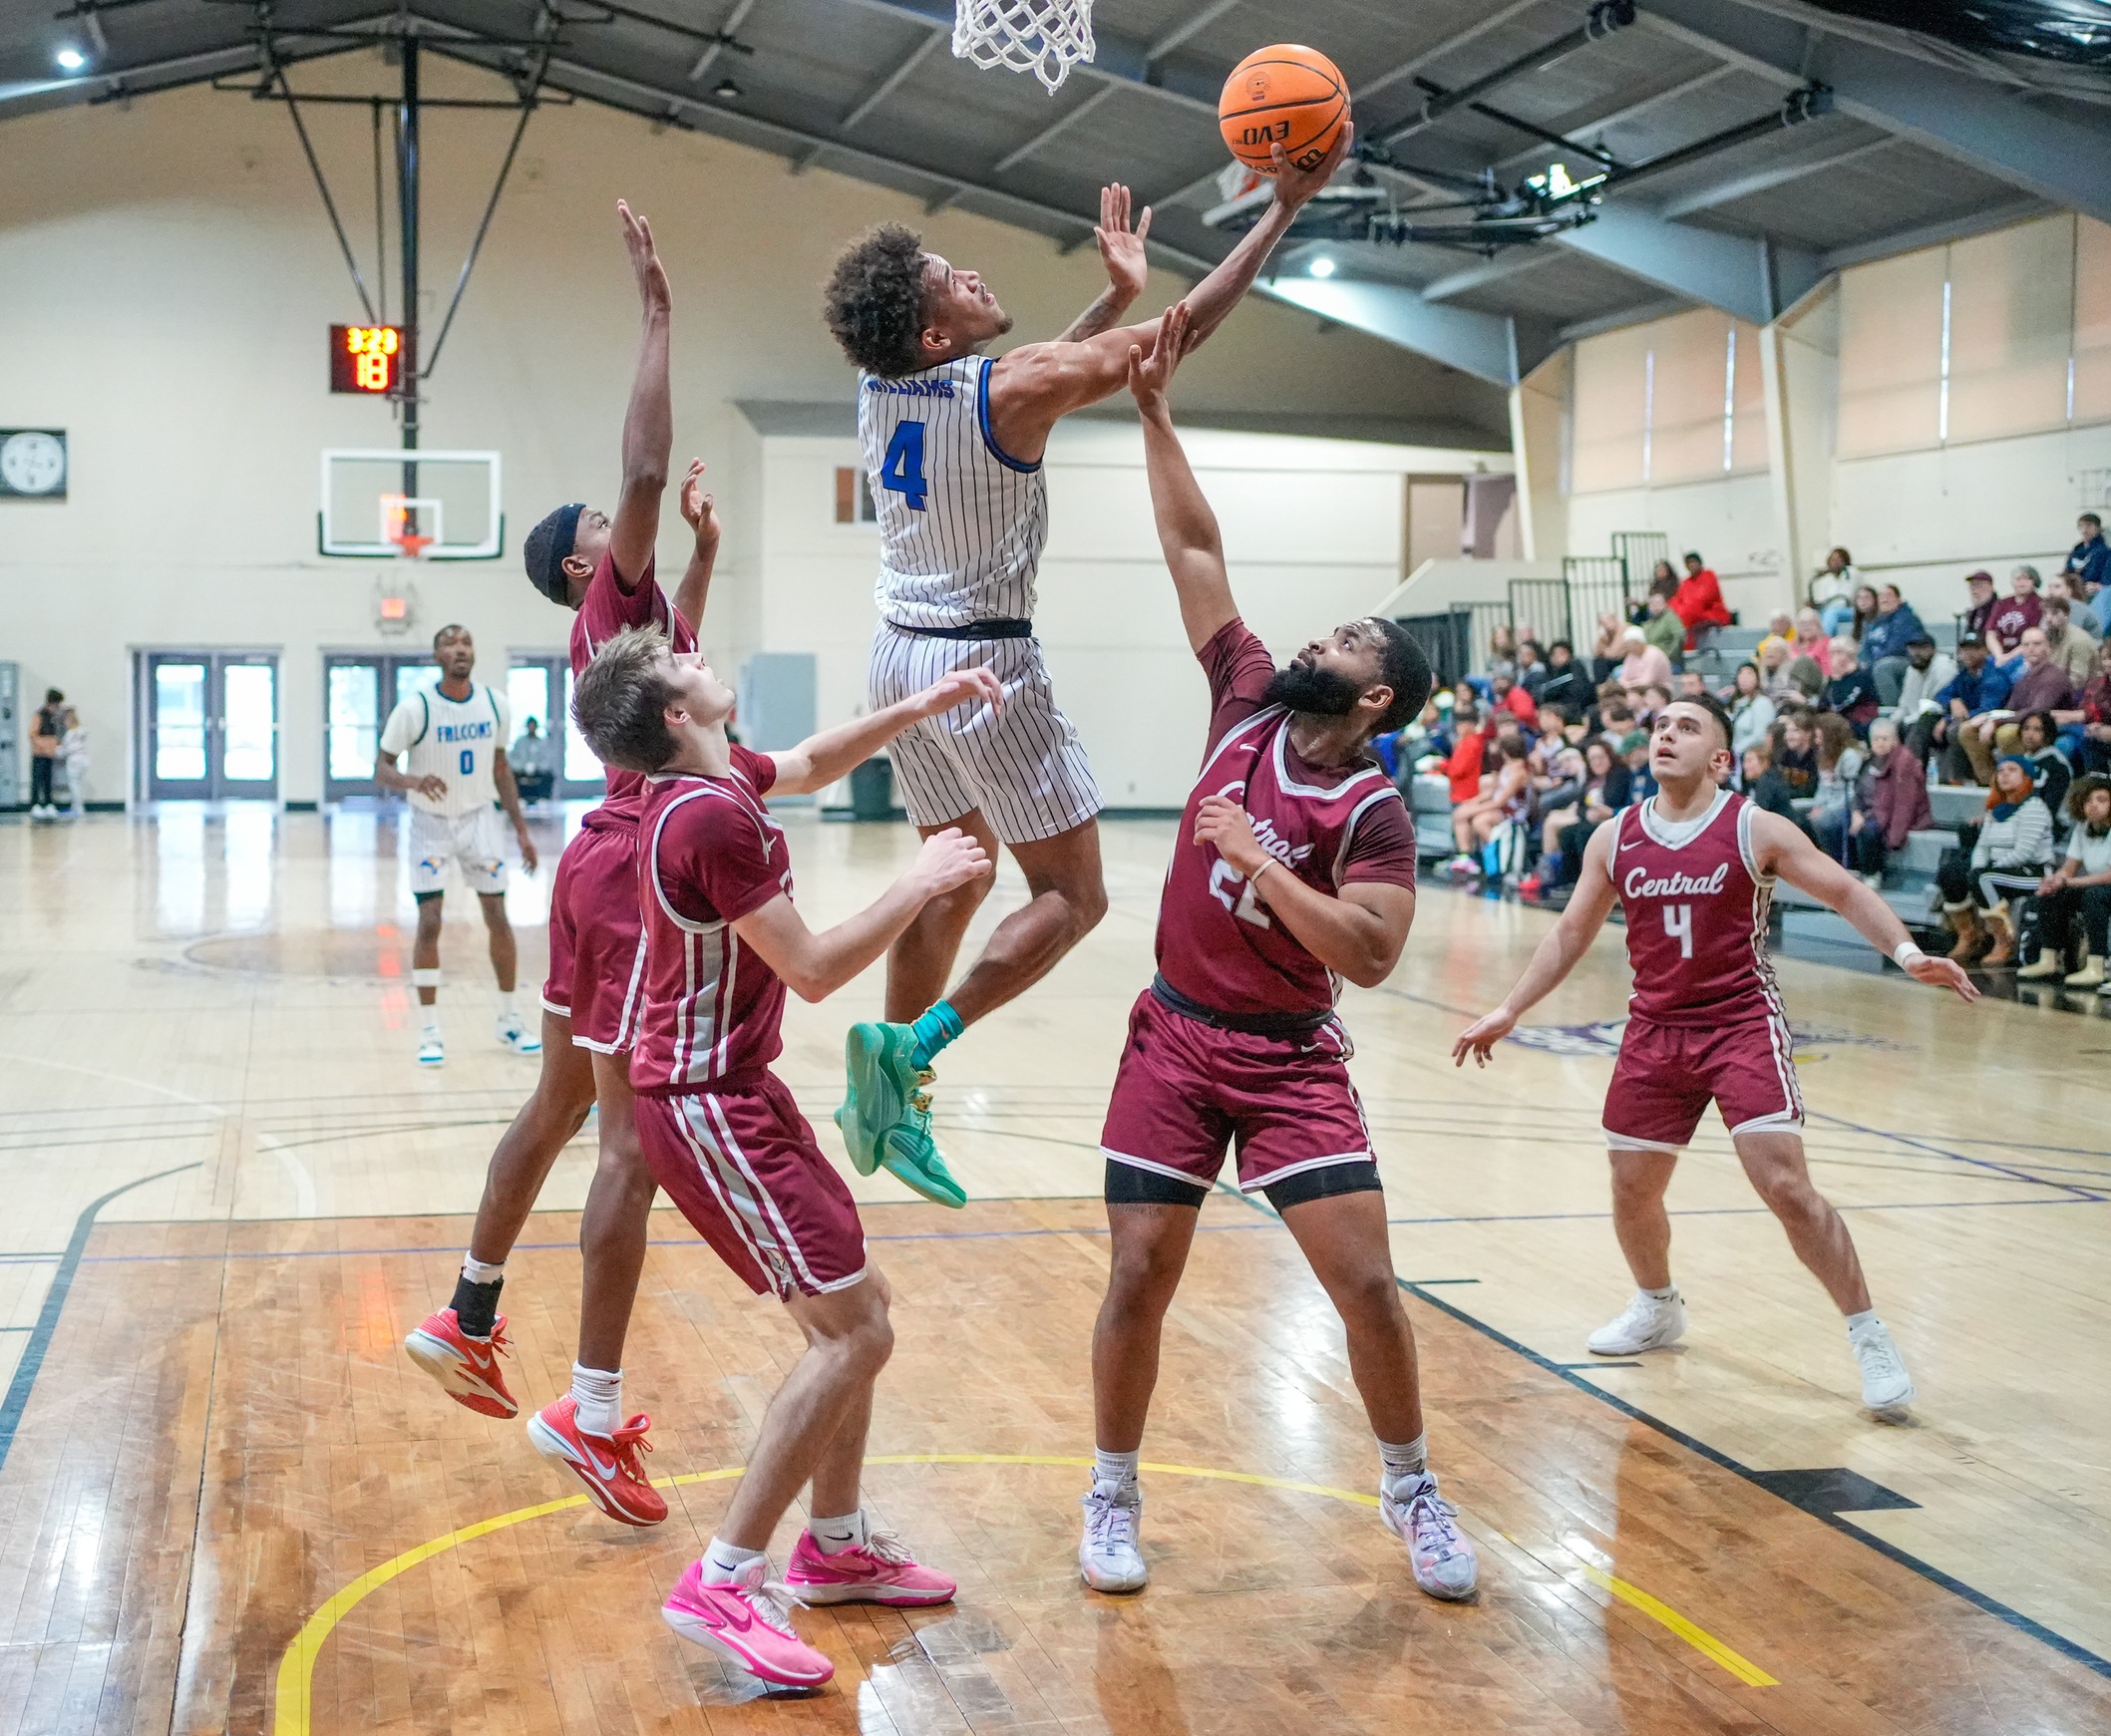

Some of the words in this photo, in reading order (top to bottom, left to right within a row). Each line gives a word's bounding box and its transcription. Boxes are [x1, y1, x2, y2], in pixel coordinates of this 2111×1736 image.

[1243, 120, 1290, 145] EVO
[357, 352, 388, 389] 18
[880, 420, 927, 512] 4
[460, 750, 474, 775] 0
[1624, 863, 1729, 898] Central
[1662, 903, 1693, 959] 4
